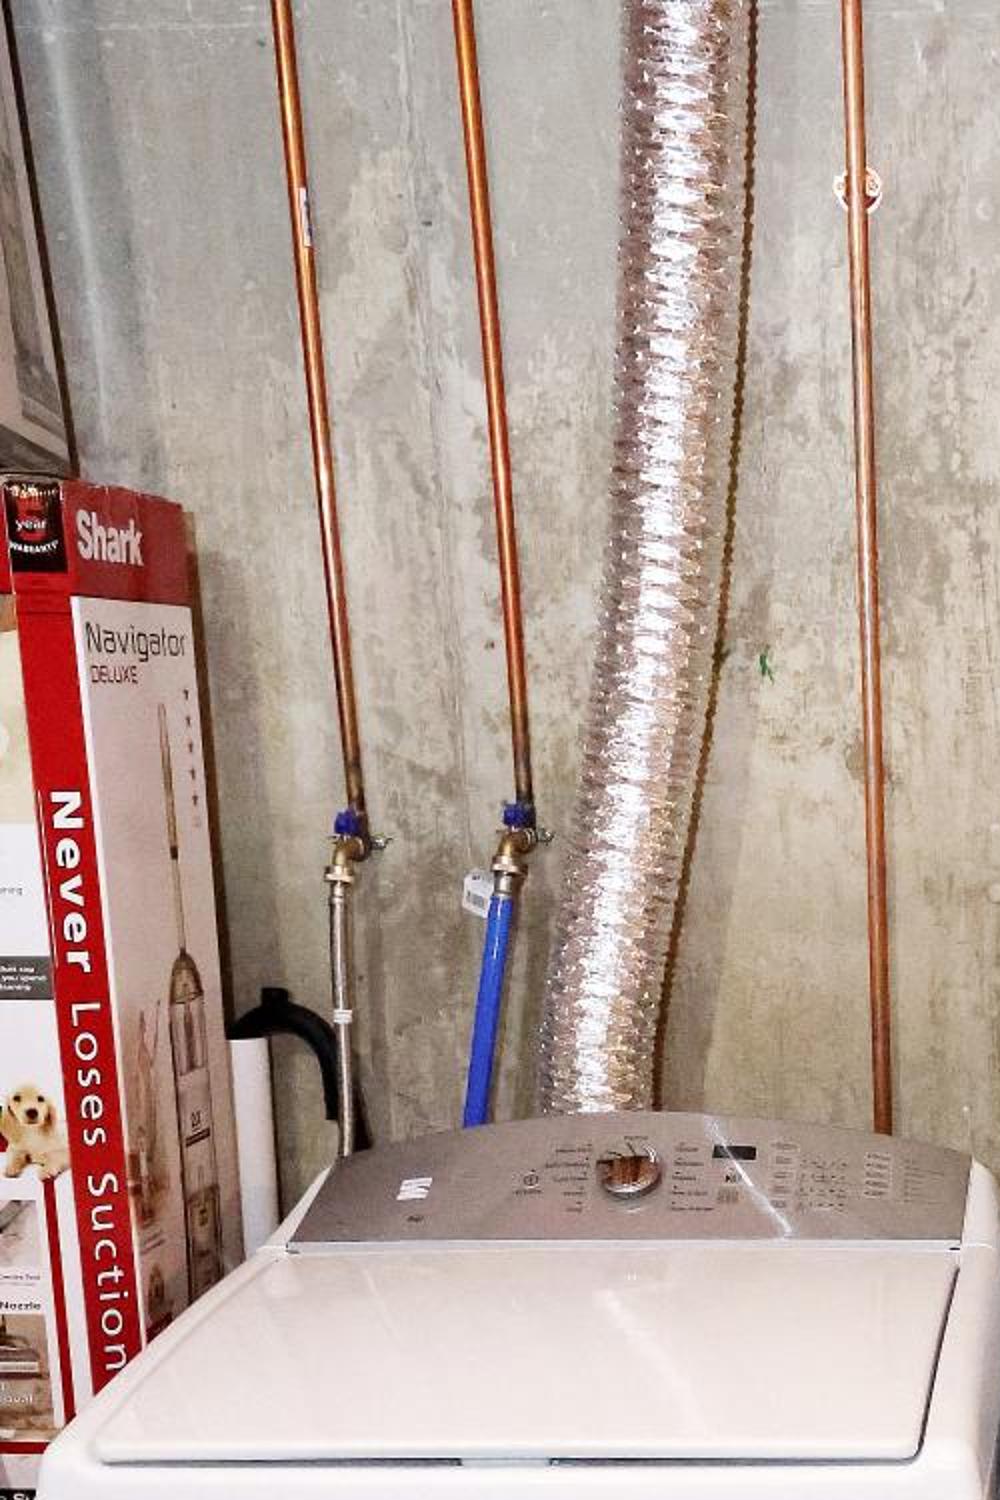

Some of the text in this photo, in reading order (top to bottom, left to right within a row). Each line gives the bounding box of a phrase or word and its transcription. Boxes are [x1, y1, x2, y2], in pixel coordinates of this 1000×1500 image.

[76, 508, 144, 566] Shark
[86, 621, 186, 662] Navigator
[91, 664, 138, 685] DELUXE
[51, 790, 129, 1371] Never Loses Suction
